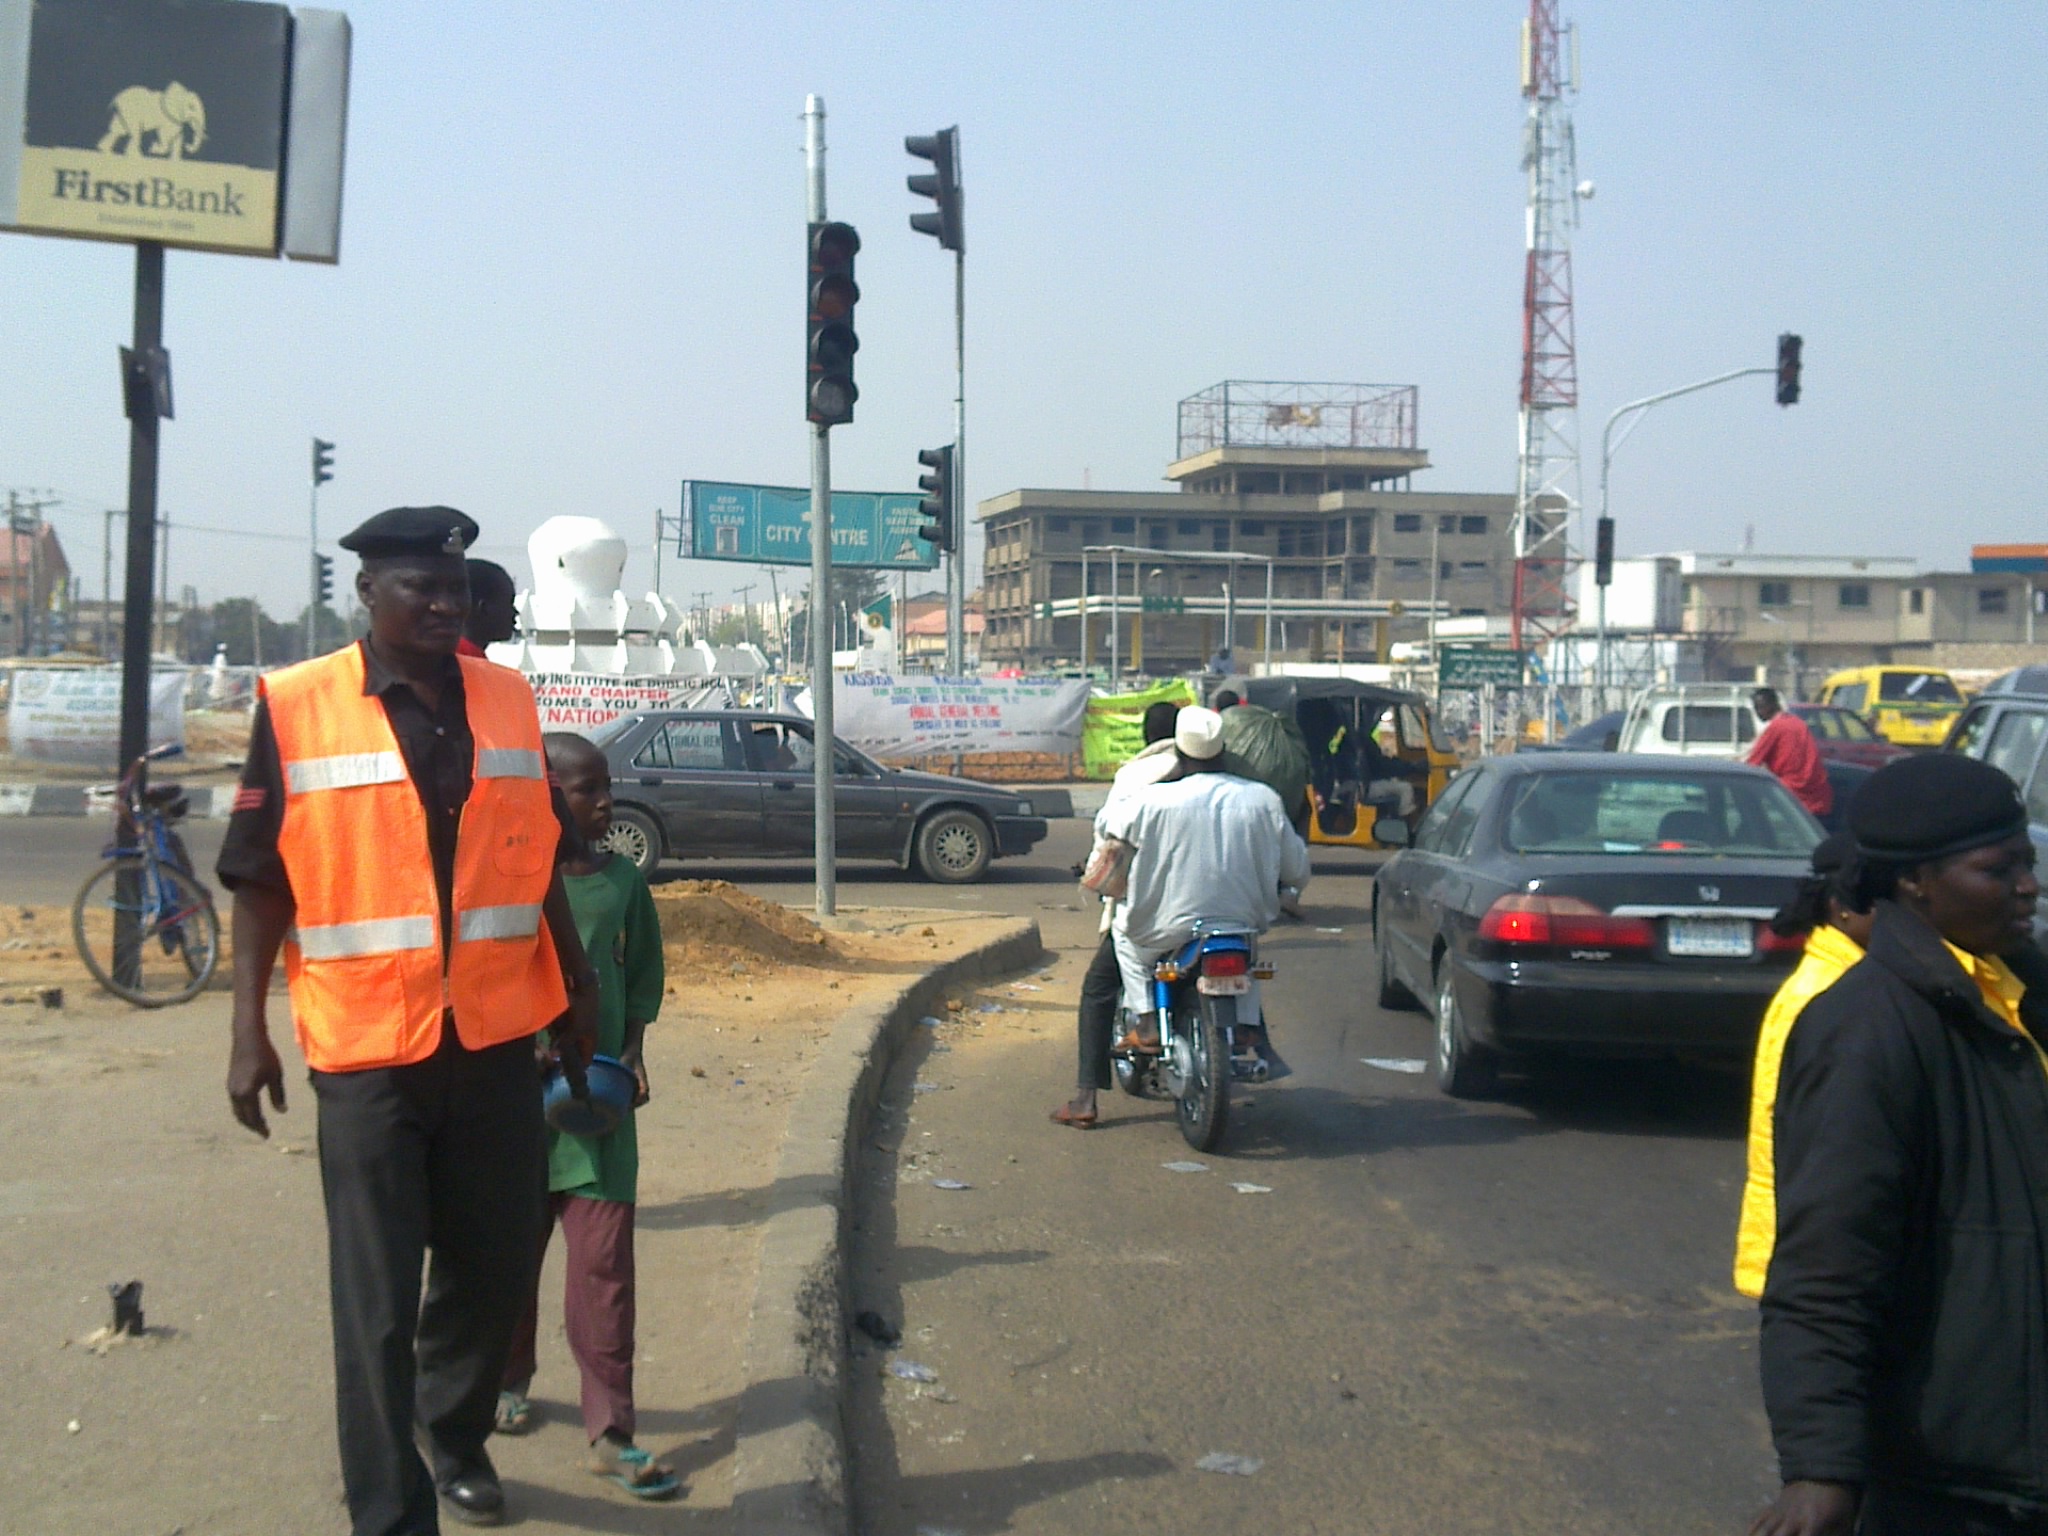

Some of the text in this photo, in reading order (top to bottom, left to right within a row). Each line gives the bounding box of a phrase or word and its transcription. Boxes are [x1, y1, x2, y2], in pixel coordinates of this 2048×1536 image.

[53, 167, 245, 217] FirstBank
[709, 513, 745, 525] CLEAN
[766, 524, 803, 543] CITY
[807, 527, 869, 546] CNTRE
[550, 673, 620, 687] INSTITUTE
[590, 687, 669, 699] CHAPTER
[603, 699, 637, 709] YOU
[547, 709, 620, 725] NATION
